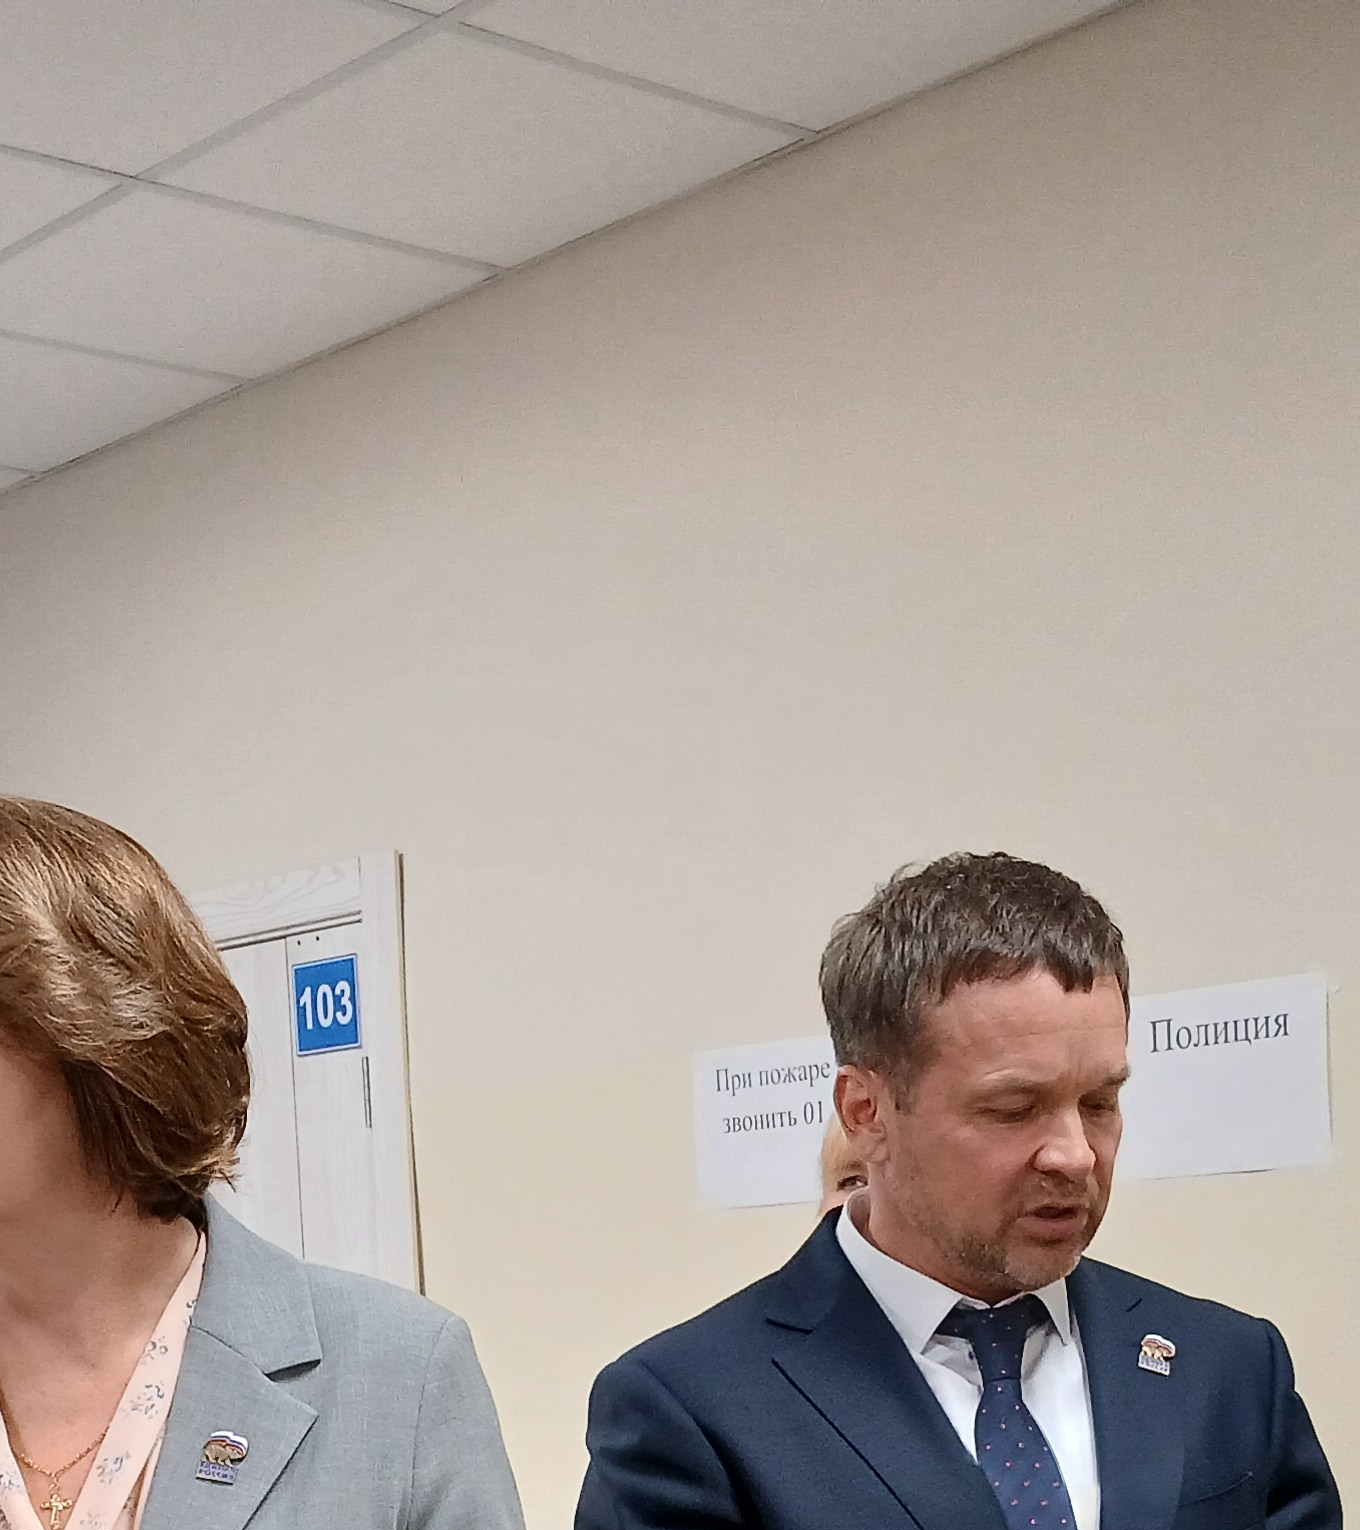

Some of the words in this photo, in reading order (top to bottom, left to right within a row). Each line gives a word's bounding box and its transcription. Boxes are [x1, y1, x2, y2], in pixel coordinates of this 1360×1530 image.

[299, 980, 353, 1030] 103
[1149, 1013, 1290, 1053] Полиция
[716, 1068, 753, 1097] При
[758, 1061, 832, 1088] пожаре
[722, 1110, 798, 1134] звонить
[803, 1100, 824, 1125] 01
